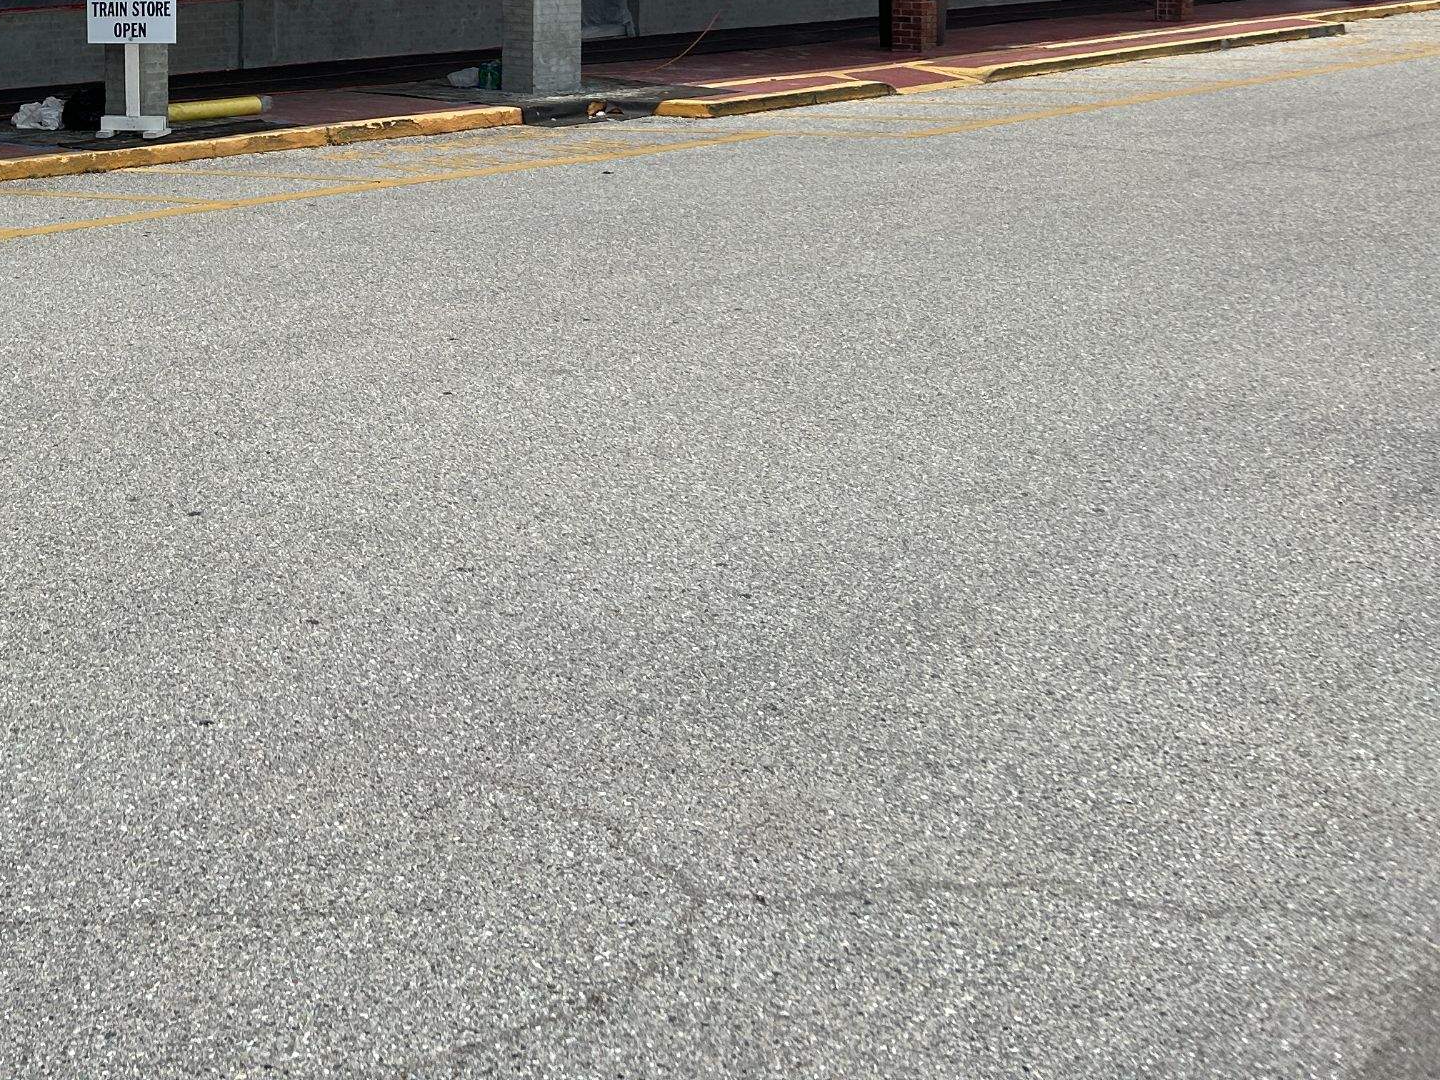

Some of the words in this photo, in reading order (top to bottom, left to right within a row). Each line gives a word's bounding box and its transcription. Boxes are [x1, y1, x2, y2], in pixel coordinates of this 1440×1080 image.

[91, 1, 128, 18] TRAIN
[132, 0, 172, 18] STORE
[113, 22, 148, 39] OPEN
